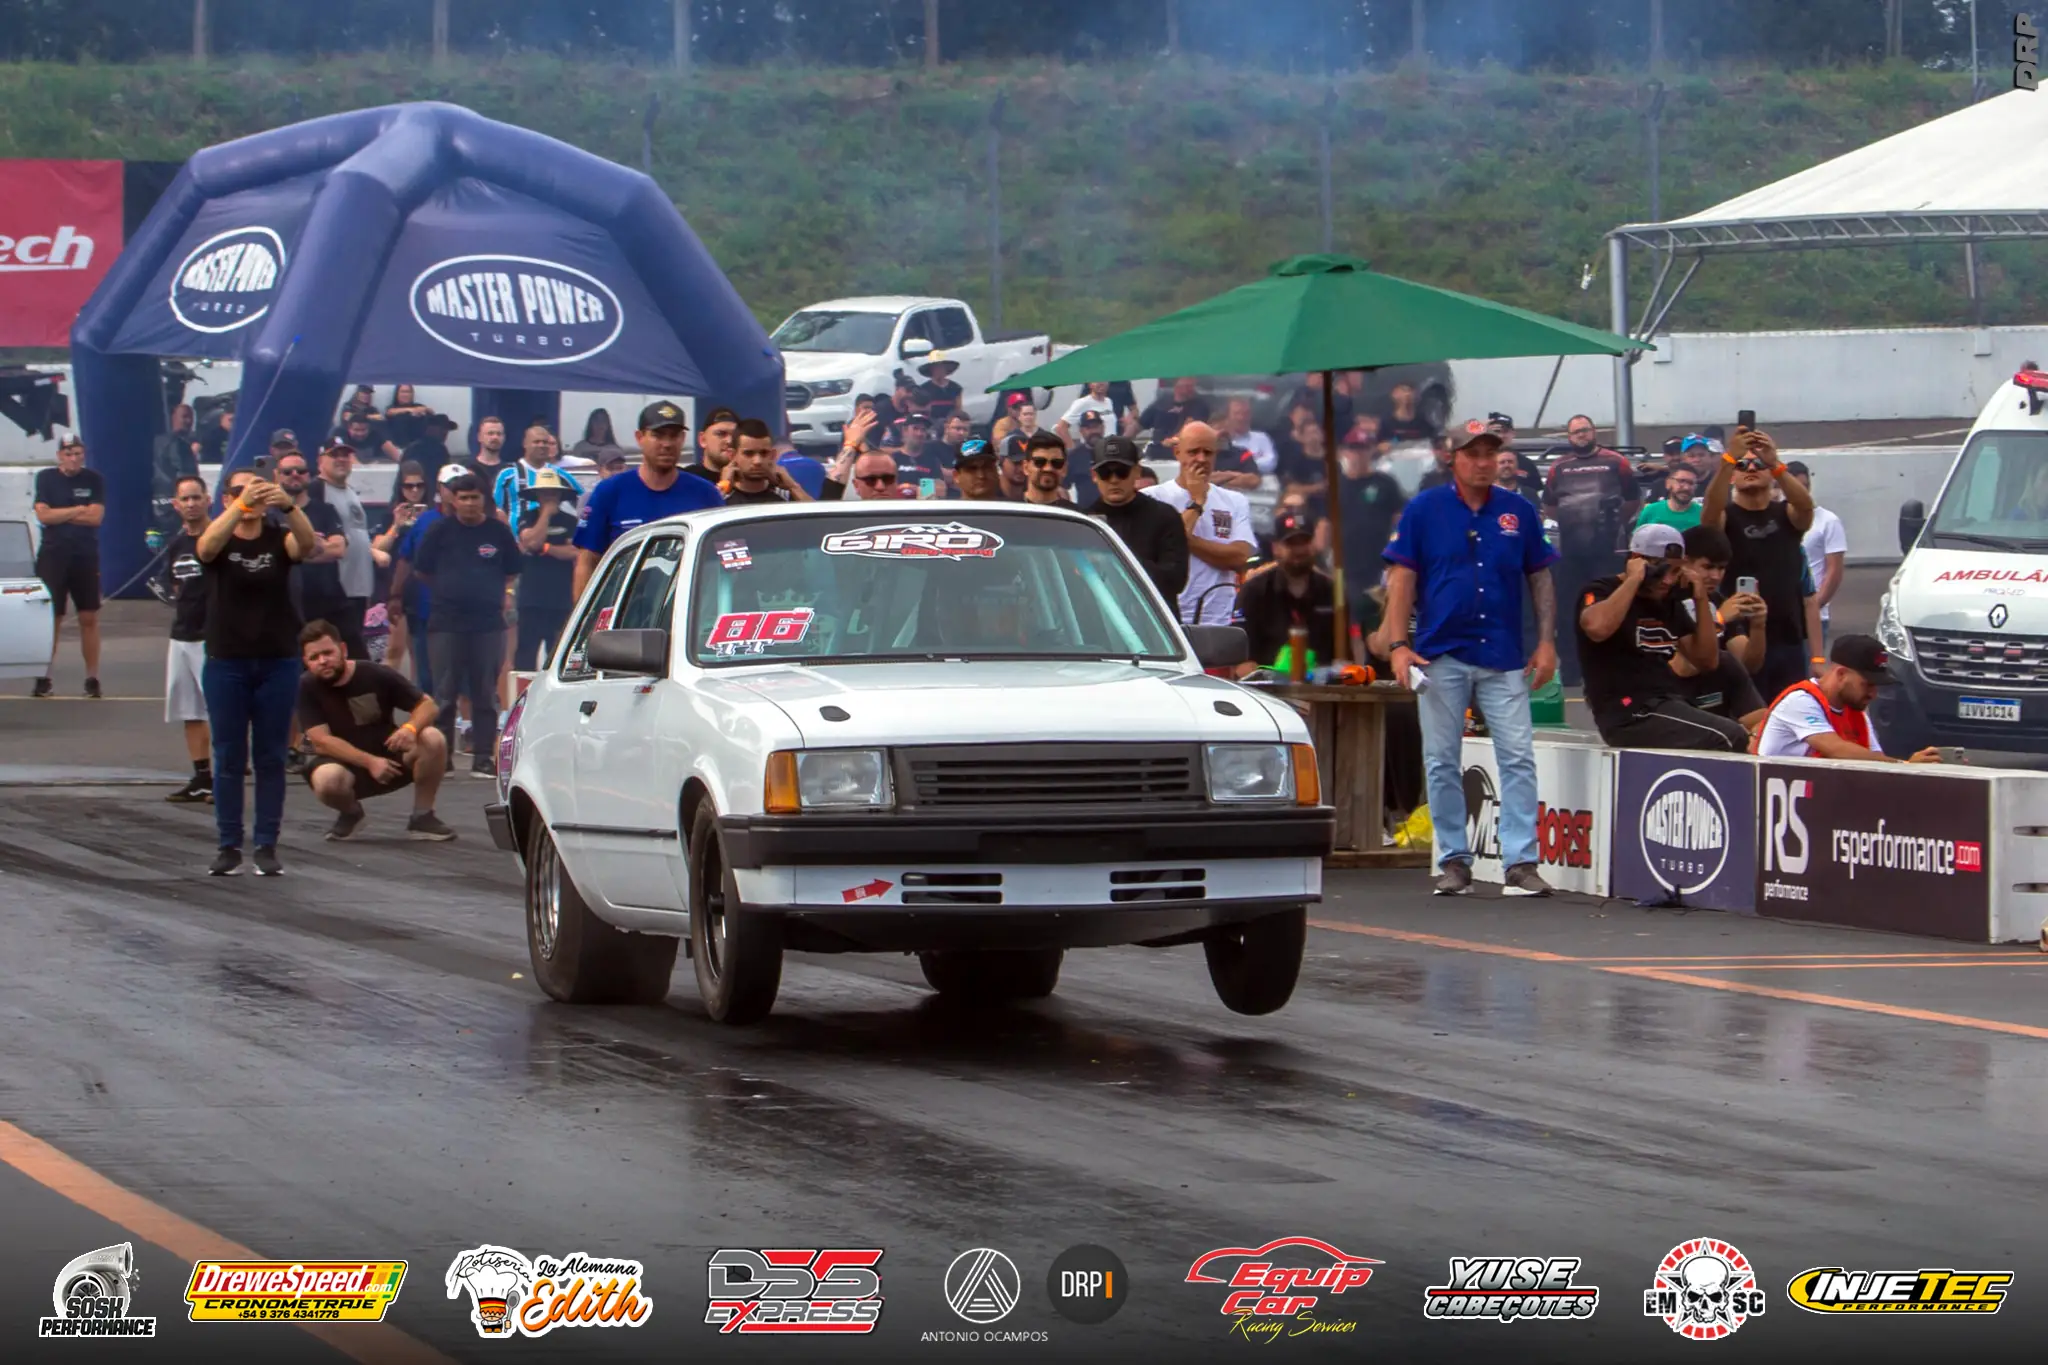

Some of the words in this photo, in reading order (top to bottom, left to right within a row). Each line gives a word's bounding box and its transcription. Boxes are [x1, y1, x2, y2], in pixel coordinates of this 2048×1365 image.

[426, 272, 519, 324] MASTER
[518, 273, 605, 325] POWER
[470, 332, 573, 347] TURBO
[826, 533, 983, 553] GIRO
[706, 610, 814, 648] 86
[1646, 790, 1685, 849] MASTER
[1684, 791, 1722, 851] POWER
[1764, 777, 1814, 875] RS
[1660, 858, 1704, 875] TURBO
[1763, 879, 1809, 901] performance
